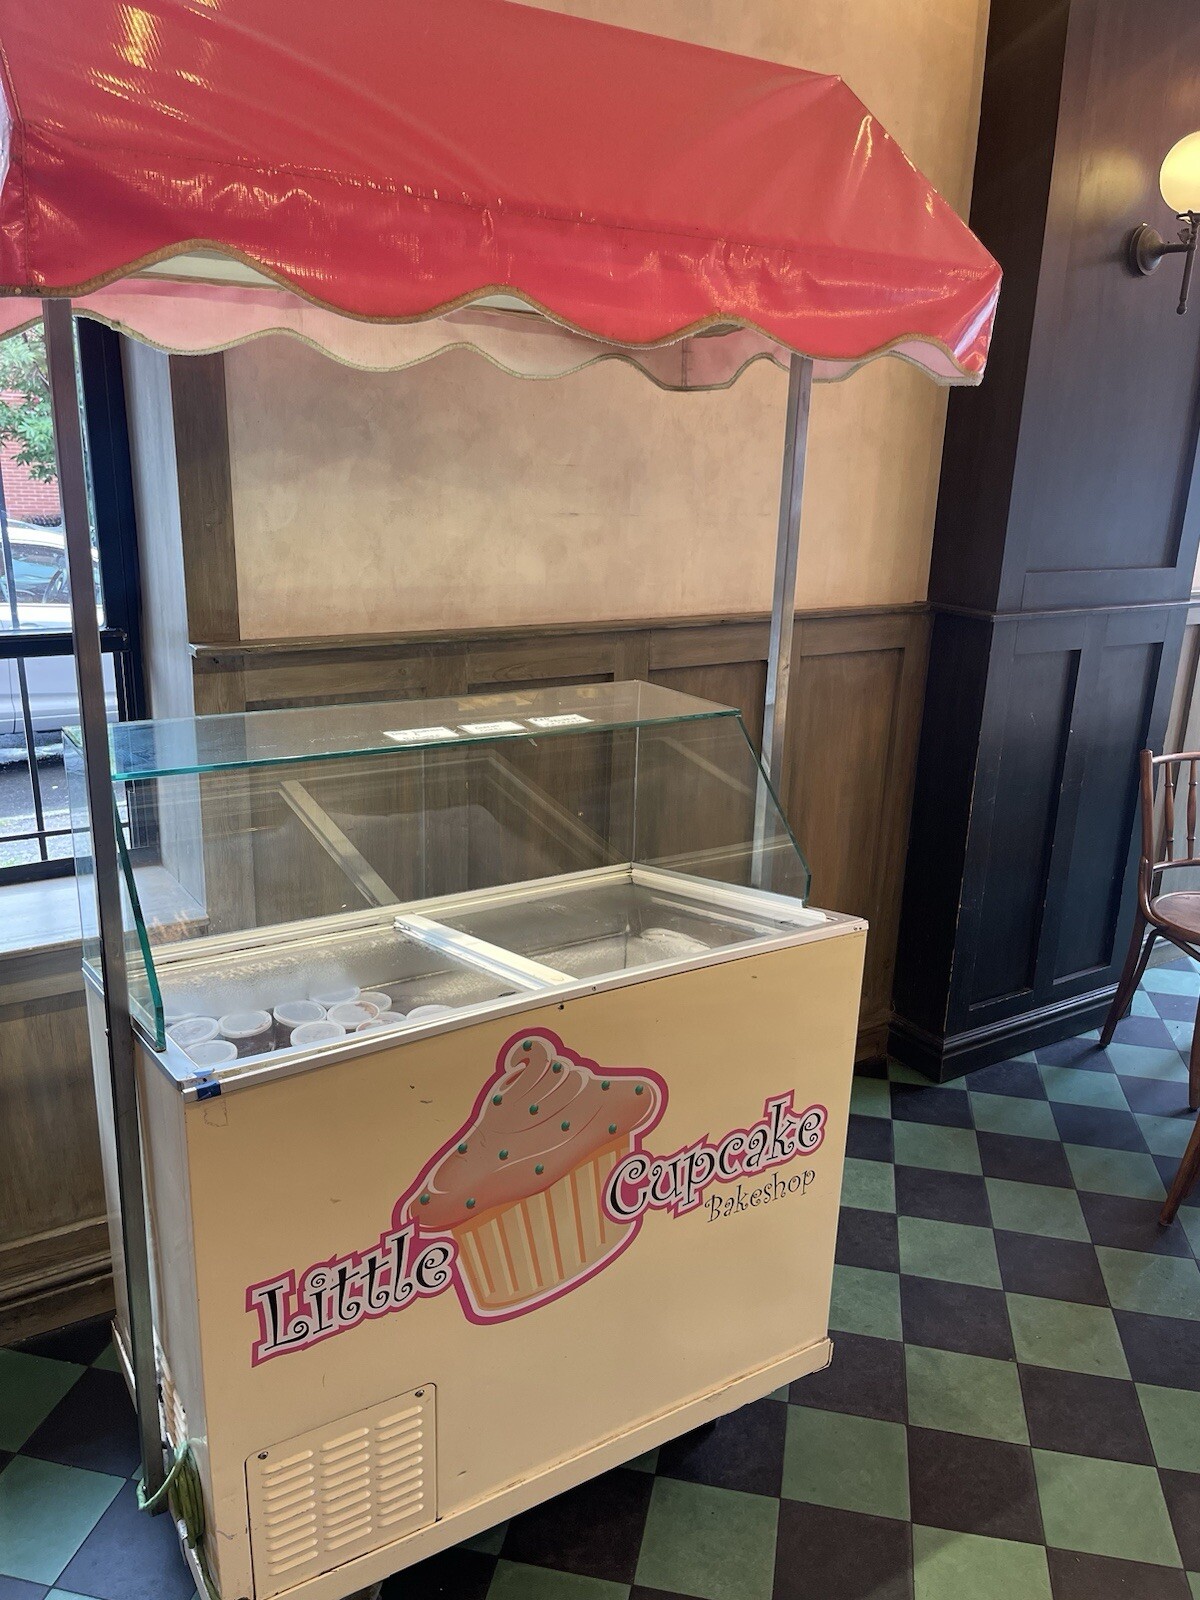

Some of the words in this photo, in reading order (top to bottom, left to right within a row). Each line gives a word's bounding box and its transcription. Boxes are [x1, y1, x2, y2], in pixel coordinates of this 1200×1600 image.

[257, 1231, 450, 1353] Little
[609, 1100, 823, 1216] Cupcake
[704, 1168, 817, 1223] Bakeshop
